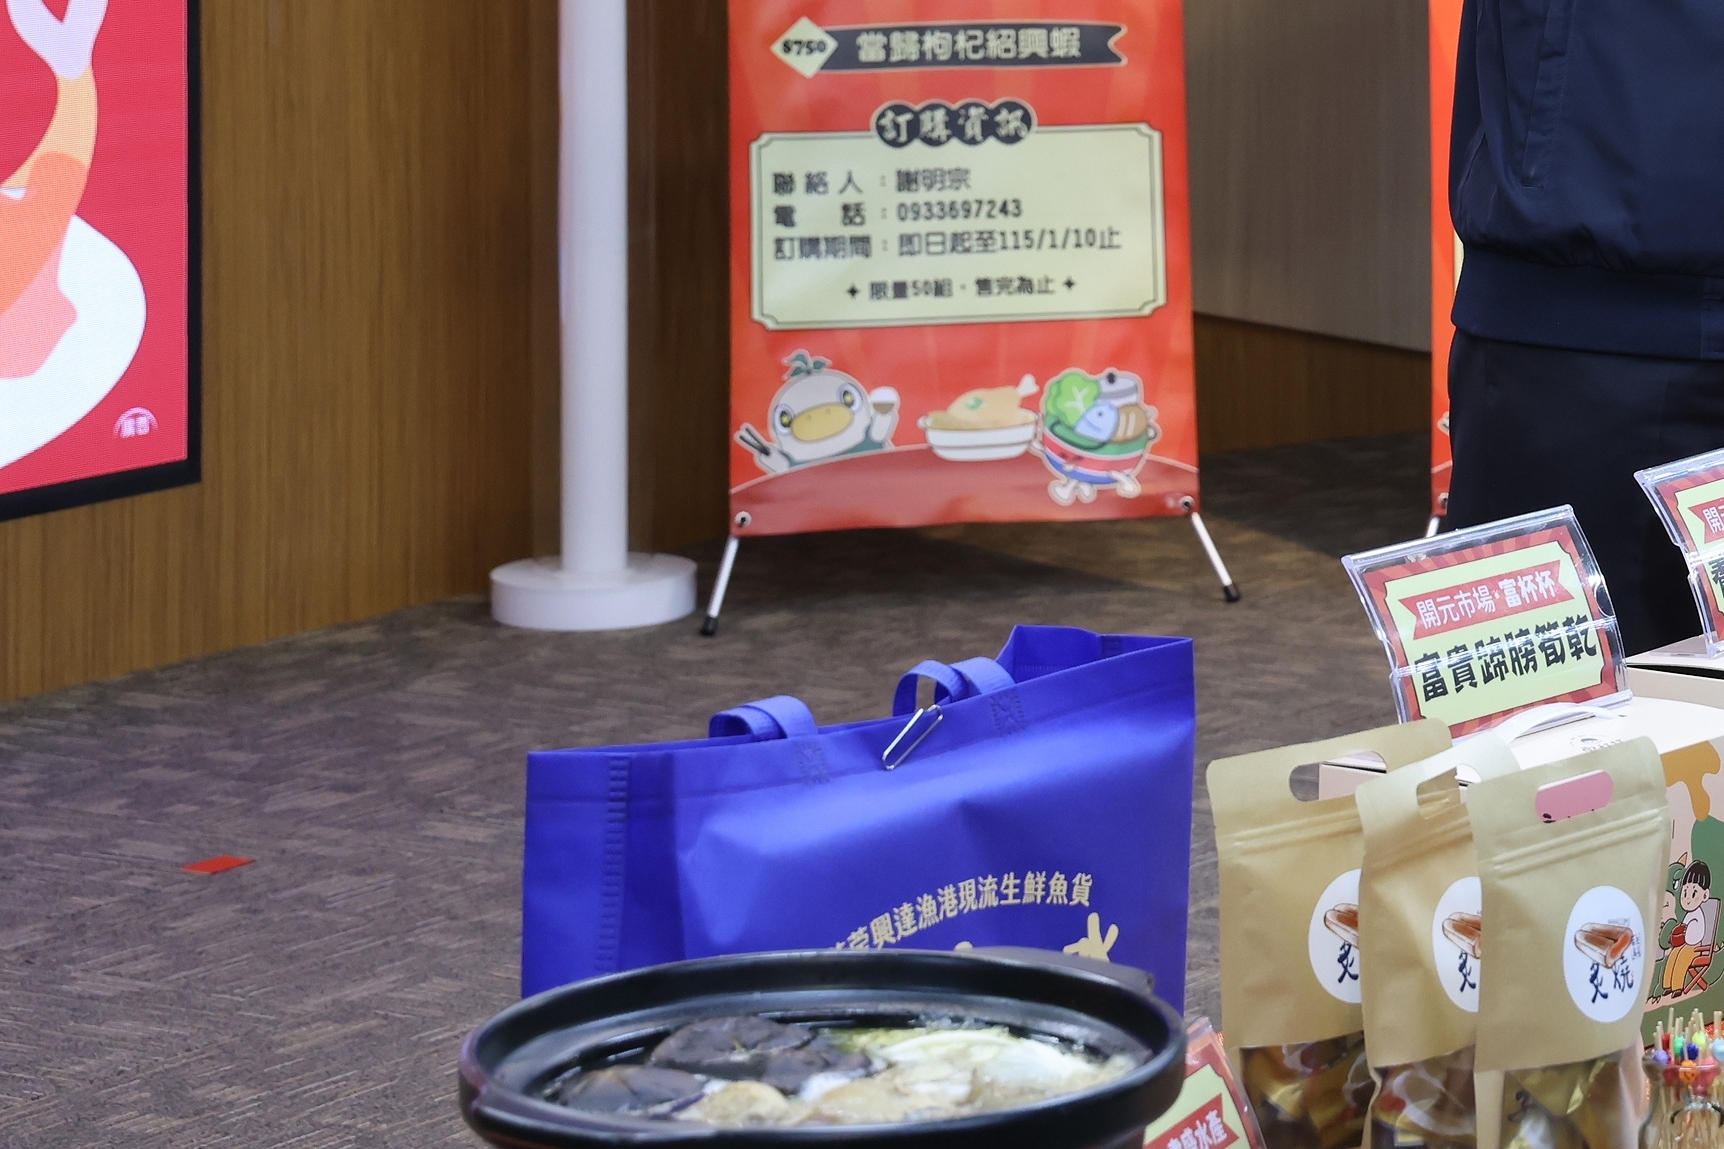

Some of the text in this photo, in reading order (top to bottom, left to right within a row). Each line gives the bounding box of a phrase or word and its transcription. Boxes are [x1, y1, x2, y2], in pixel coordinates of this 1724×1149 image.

[856, 27, 1082, 63] 當歸枸杞紹興蝦
[896, 167, 971, 192] 謝明宗
[896, 198, 1024, 222] 0933697243
[897, 225, 1123, 257] 即日起至115/1/10止
